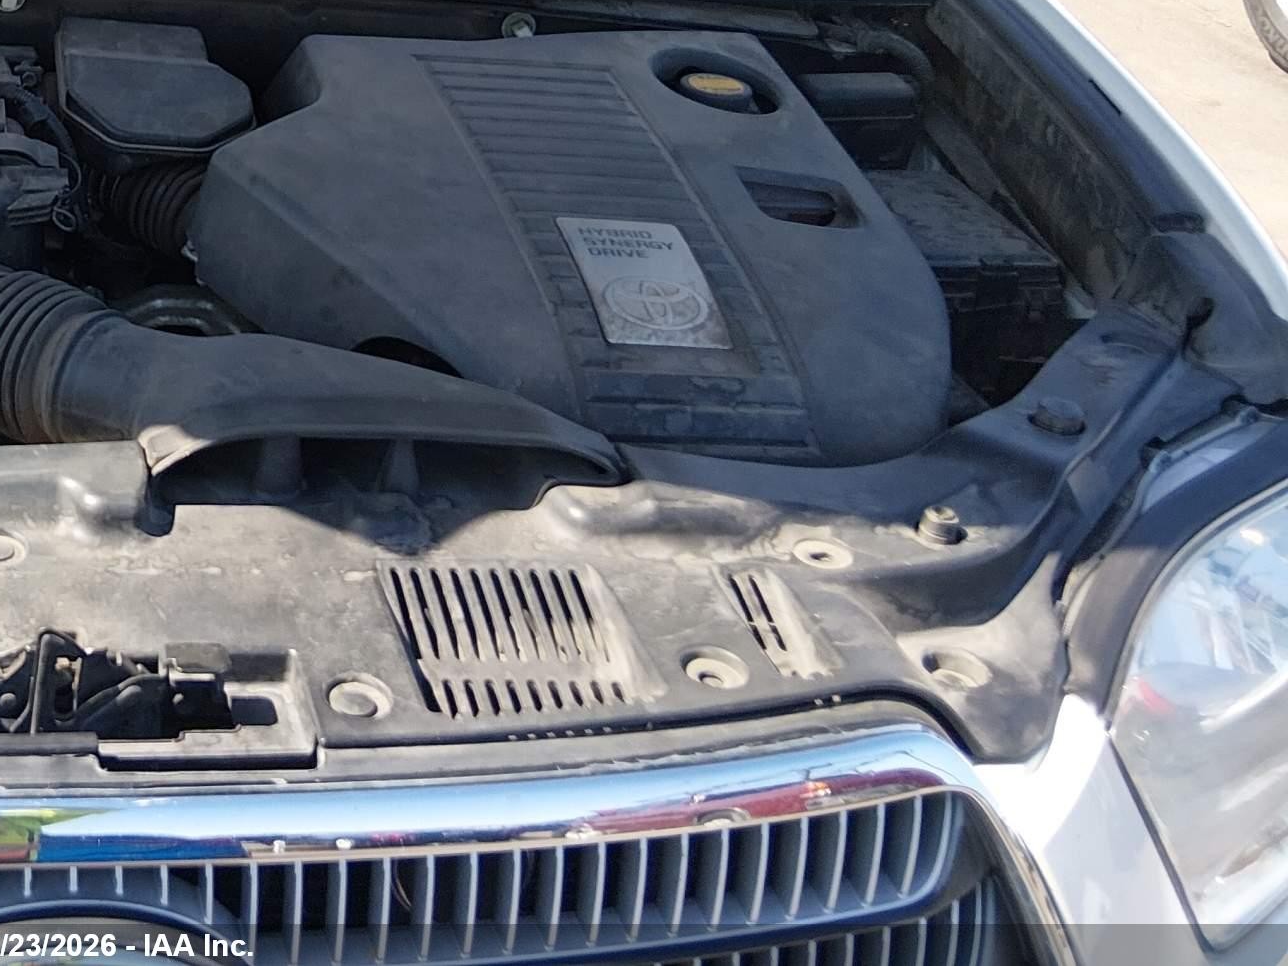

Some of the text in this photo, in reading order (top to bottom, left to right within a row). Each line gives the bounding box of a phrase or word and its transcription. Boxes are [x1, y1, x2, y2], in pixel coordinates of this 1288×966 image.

[578, 227, 652, 238] HYBRID
[584, 238, 673, 250] SYNERGY
[588, 248, 649, 258] DRIVE
